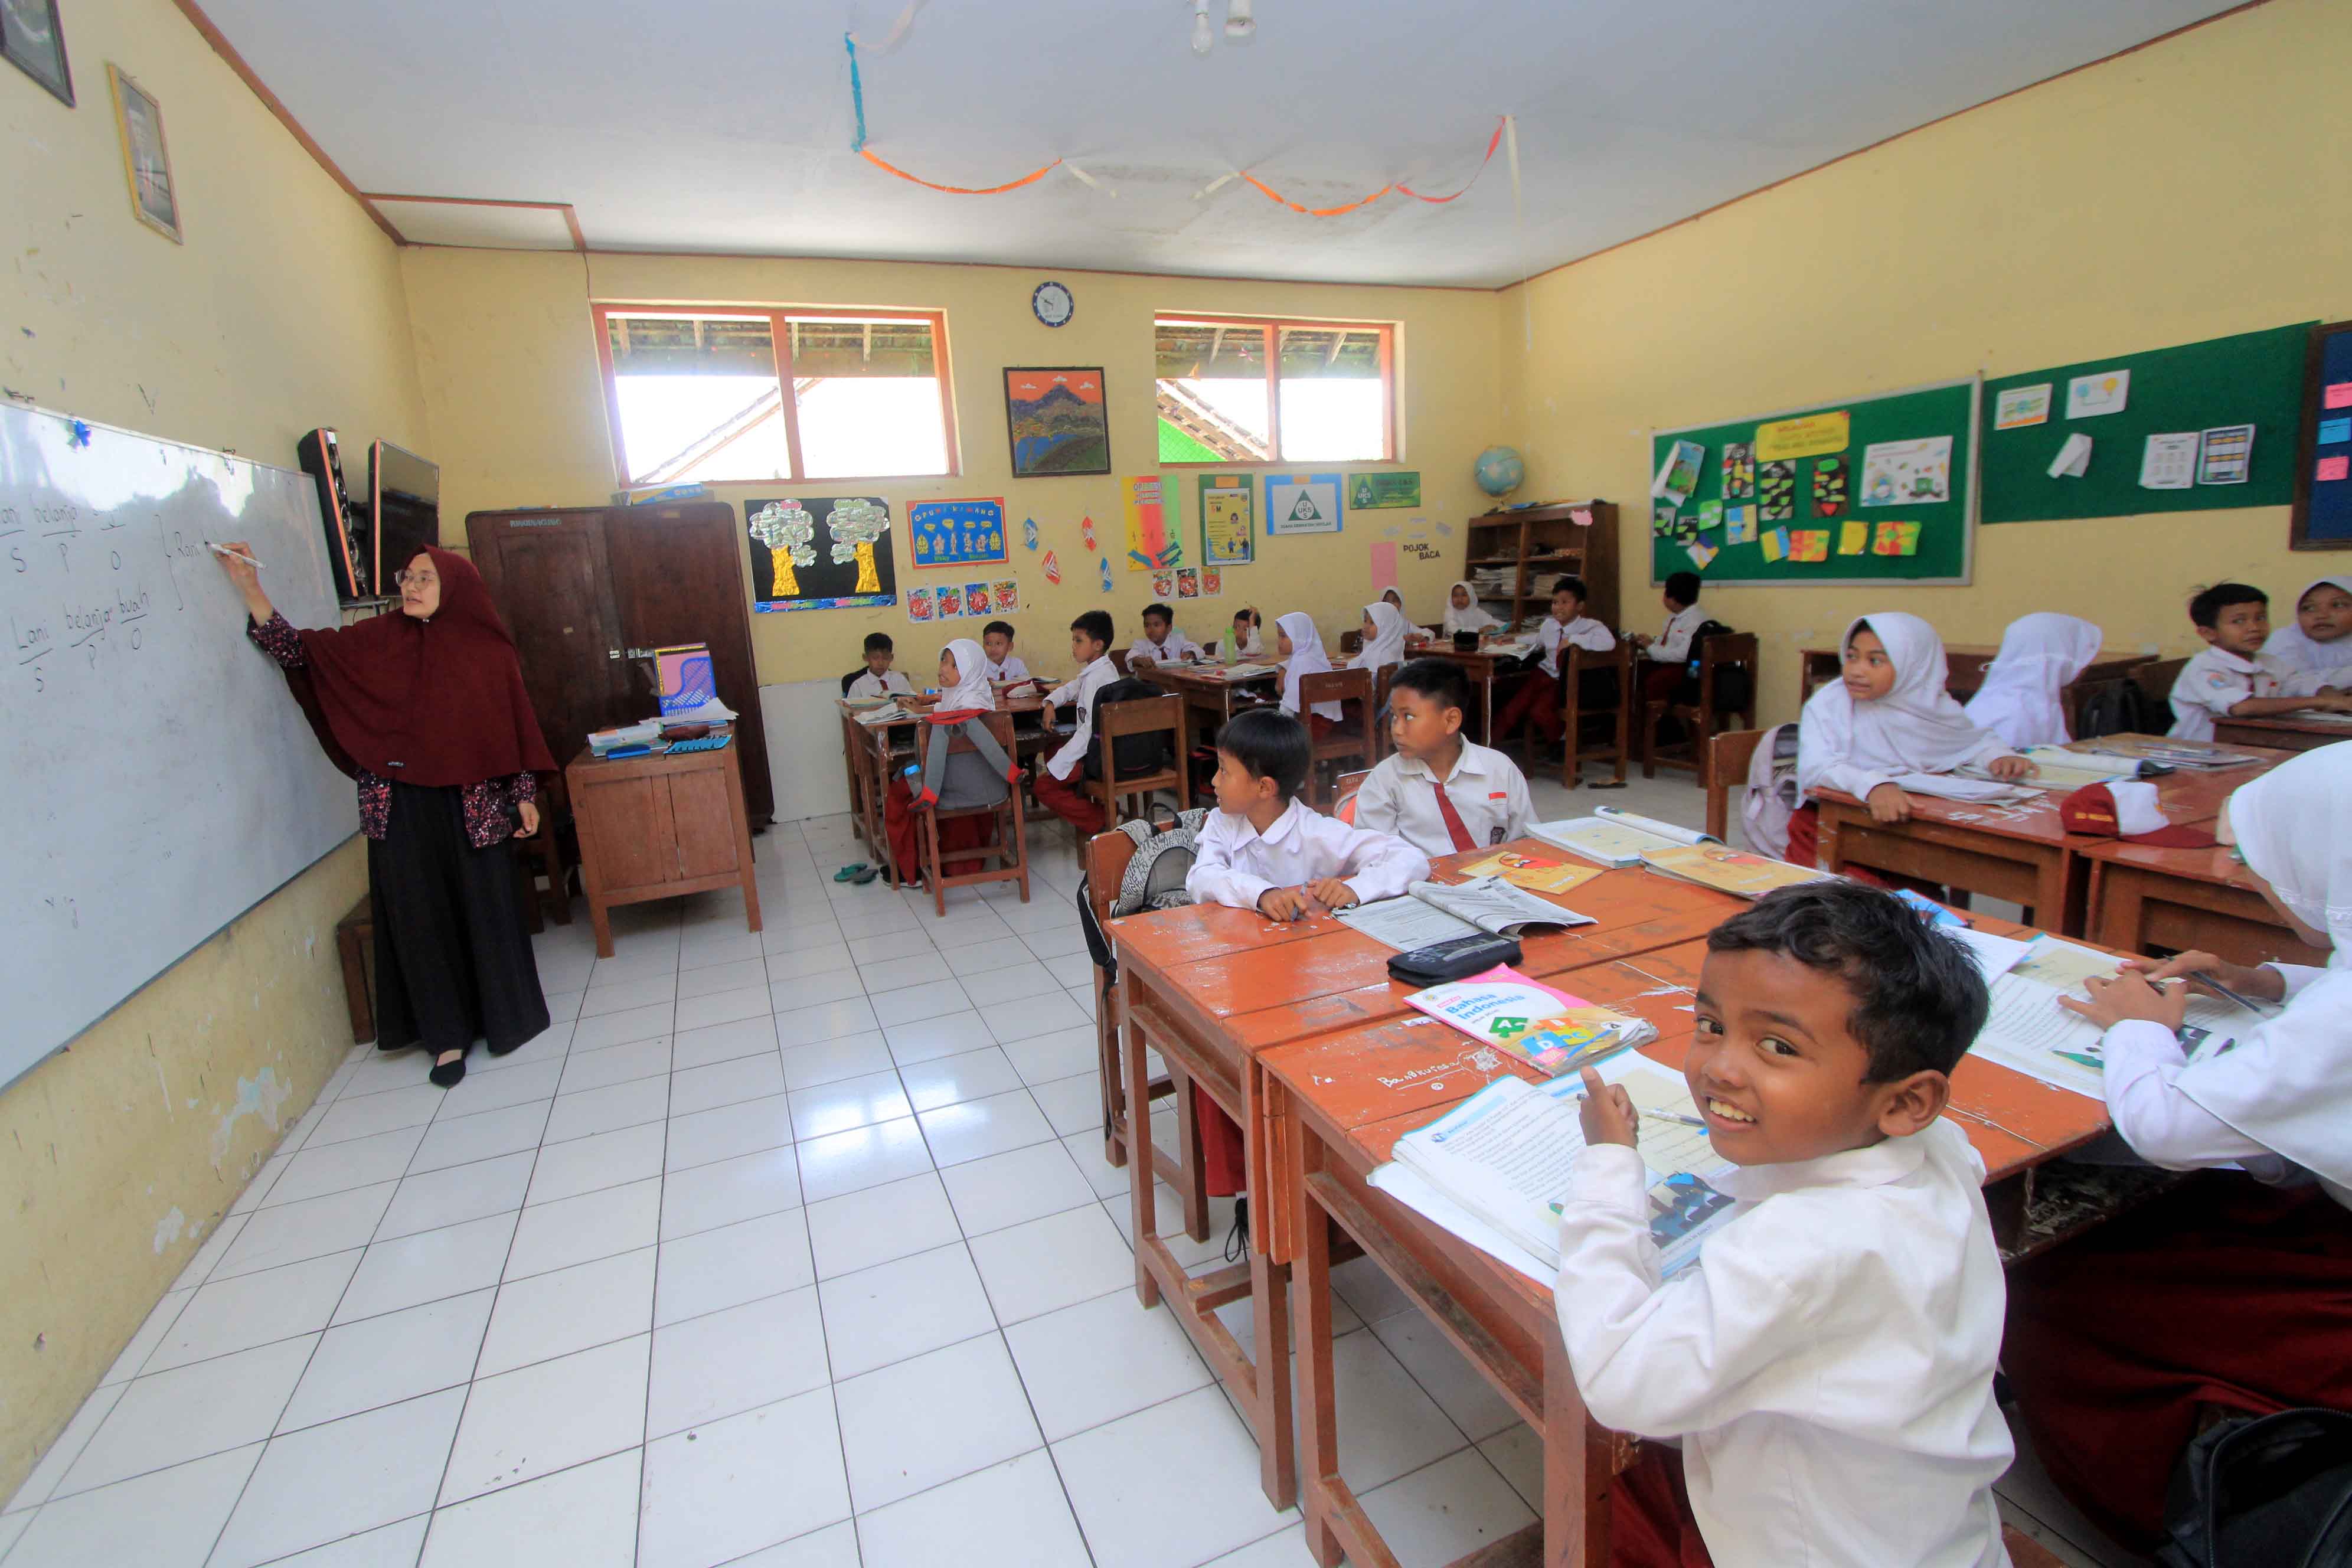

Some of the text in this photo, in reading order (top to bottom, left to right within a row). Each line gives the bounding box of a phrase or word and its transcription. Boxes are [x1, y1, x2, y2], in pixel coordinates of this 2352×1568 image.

[1403, 543, 1429, 552] POJOK
[1419, 550, 1441, 560] BACA
[1446, 993, 1498, 1014] Bahasa
[1456, 995, 1525, 1020] Indonesia
